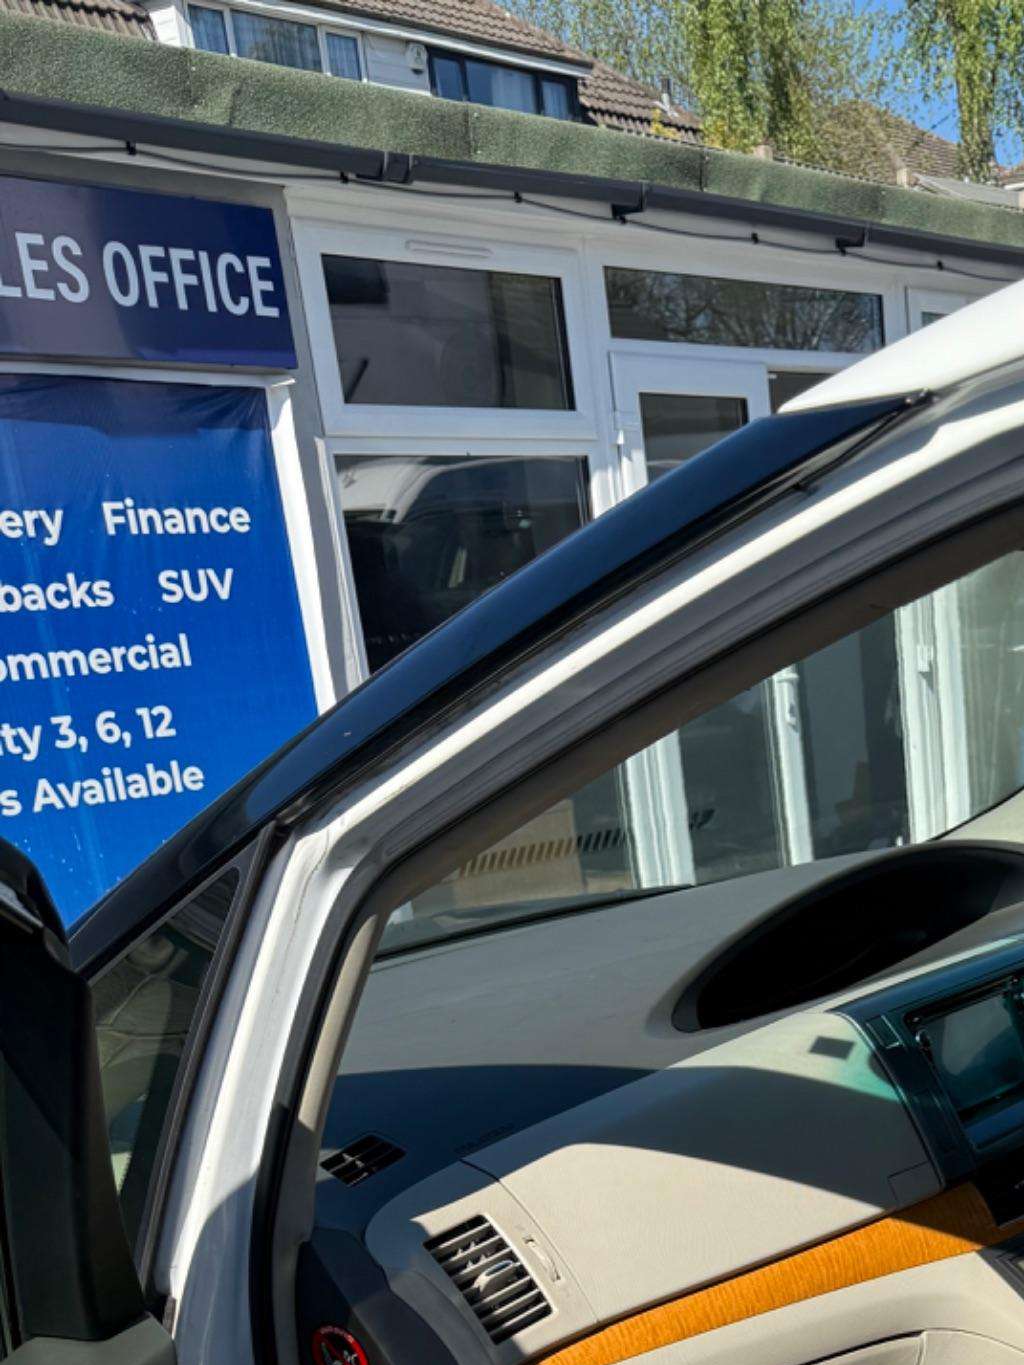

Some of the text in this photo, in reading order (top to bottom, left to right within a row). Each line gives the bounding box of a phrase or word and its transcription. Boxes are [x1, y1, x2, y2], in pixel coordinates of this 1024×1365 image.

[102, 240, 281, 318] OFFICE
[0, 497, 251, 547] ery Finance
[157, 567, 234, 604] SUV
[0, 704, 178, 763] ty 3, 6, 12
[32, 759, 205, 813] Available
